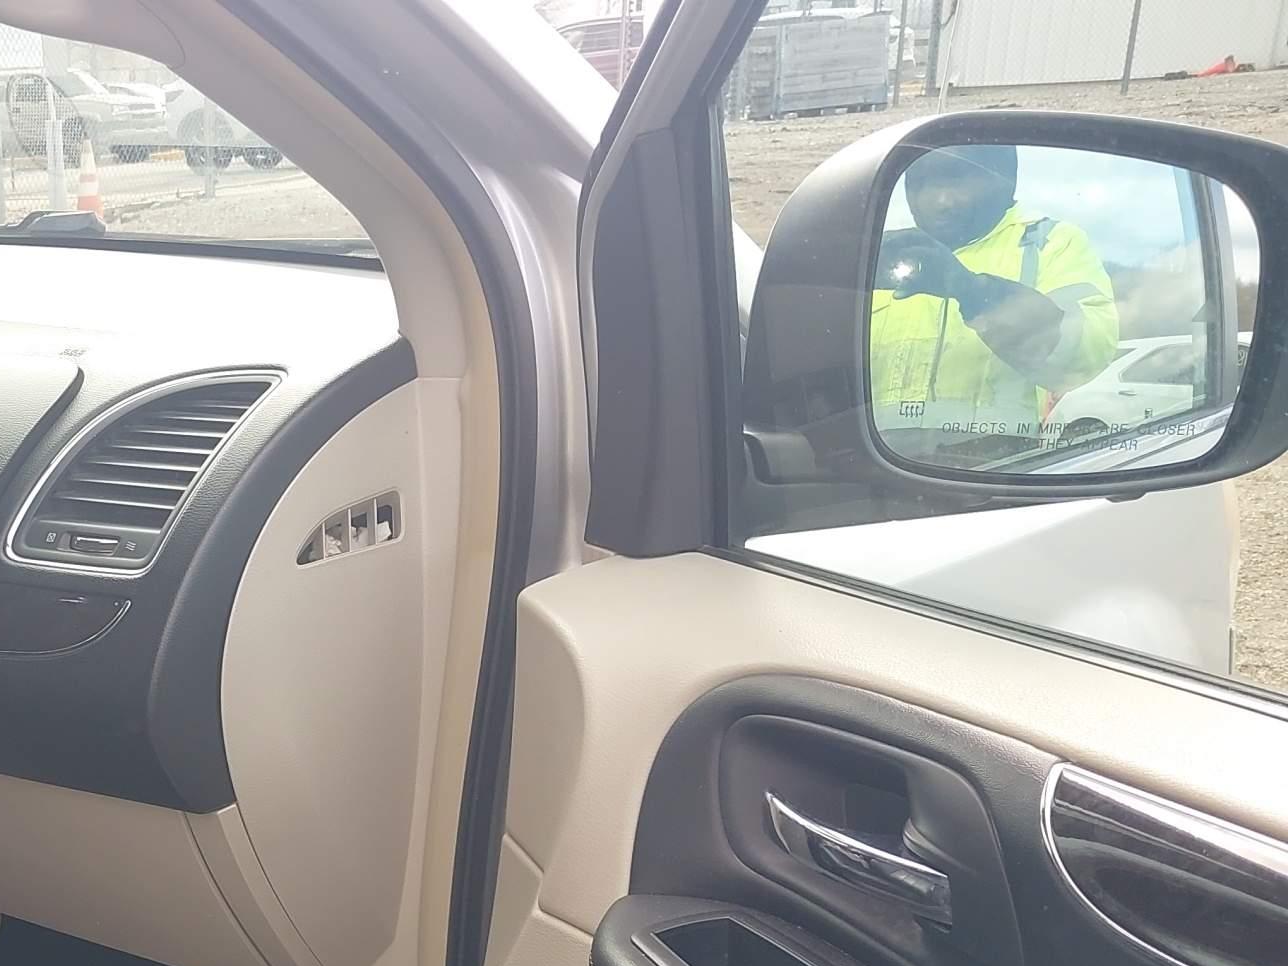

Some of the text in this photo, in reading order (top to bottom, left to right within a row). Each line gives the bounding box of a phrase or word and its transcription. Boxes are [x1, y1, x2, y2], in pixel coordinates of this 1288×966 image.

[941, 422, 1008, 434] OBJECTS
[1016, 422, 1031, 434] IN
[1136, 424, 1196, 436] CLOSER
[1038, 438, 1074, 450] THEY
